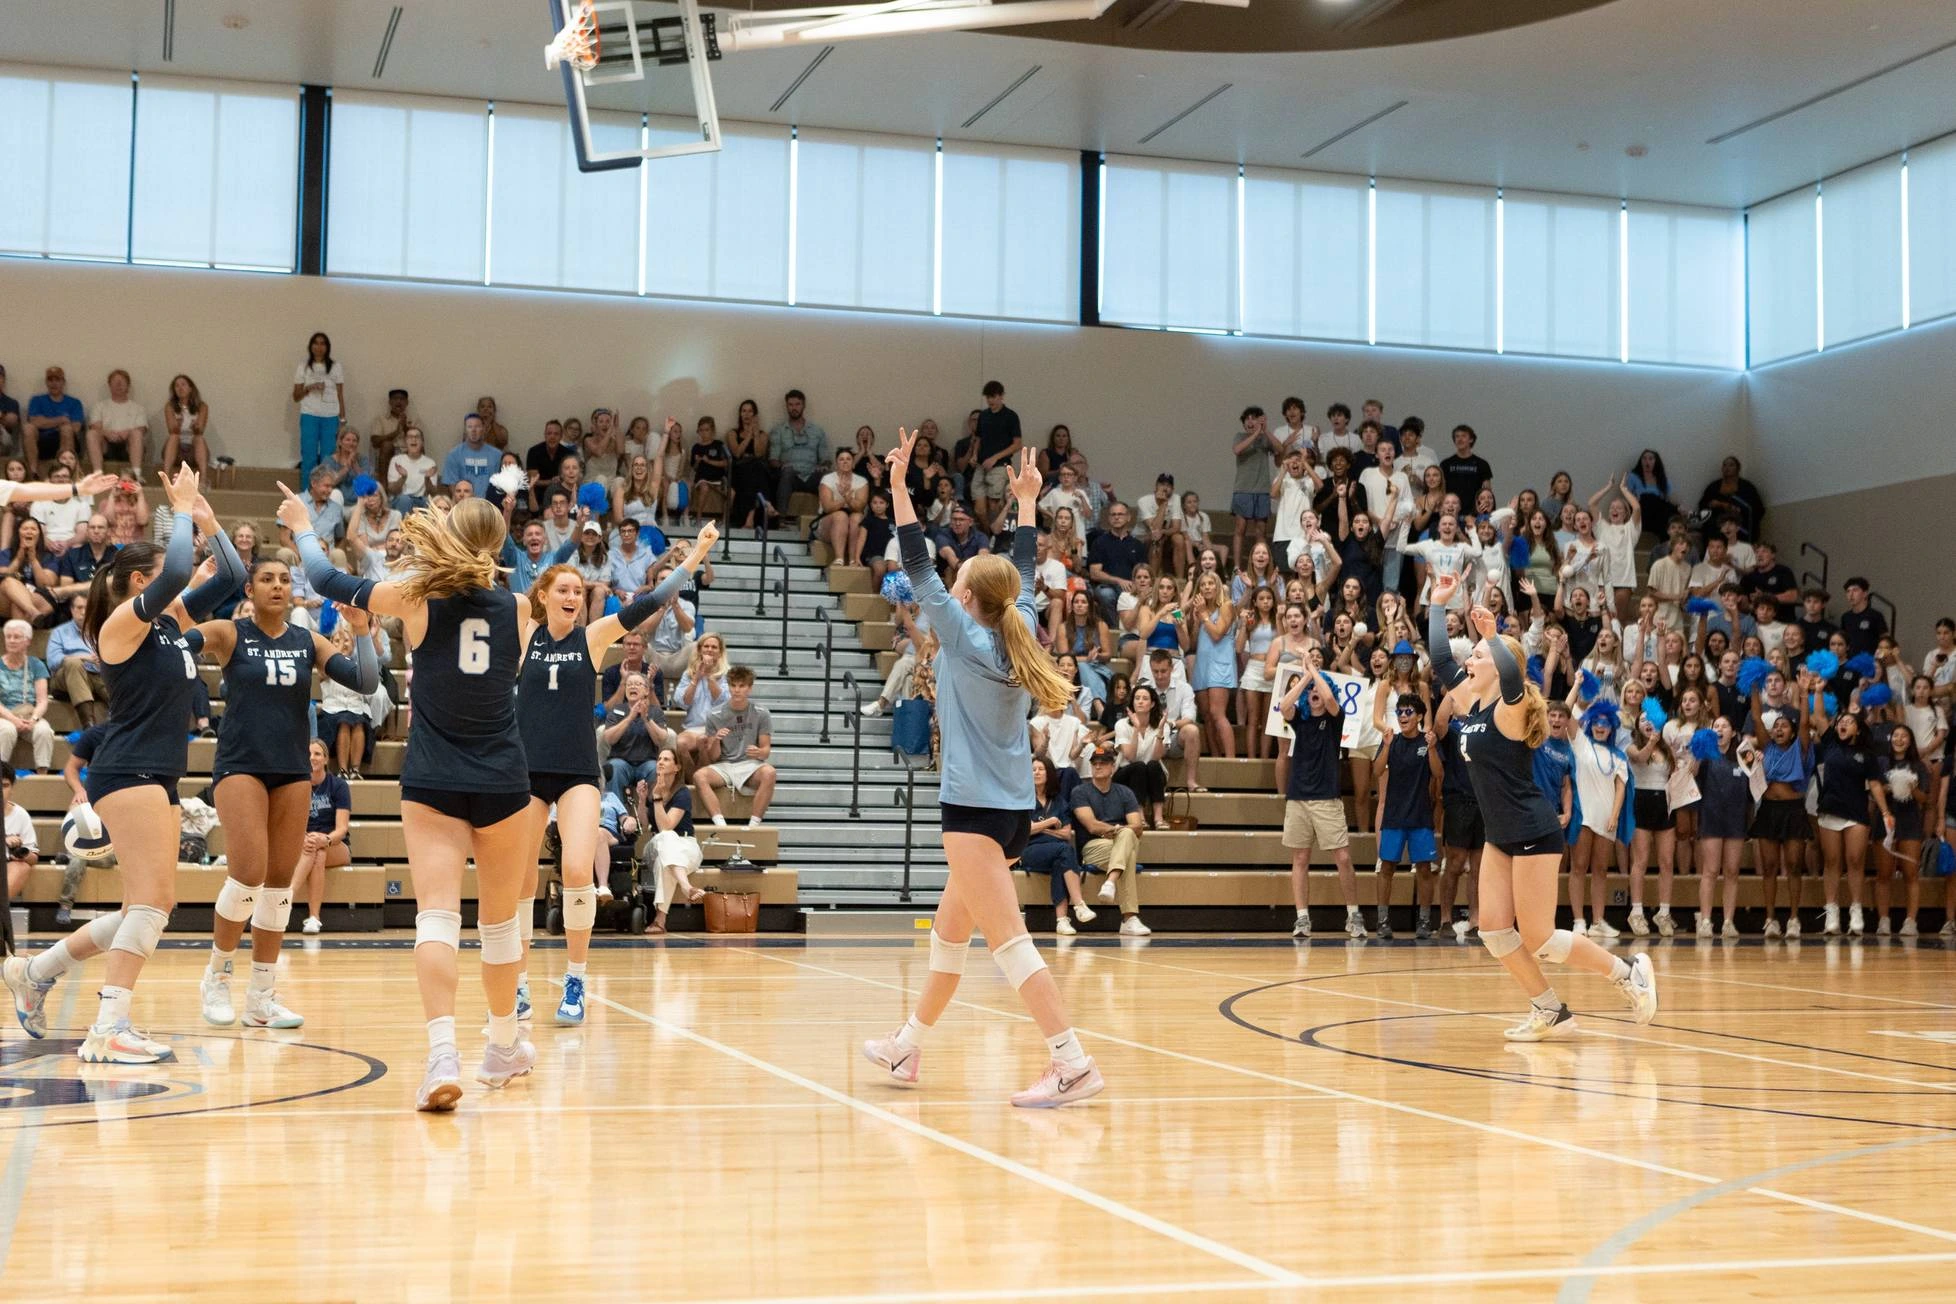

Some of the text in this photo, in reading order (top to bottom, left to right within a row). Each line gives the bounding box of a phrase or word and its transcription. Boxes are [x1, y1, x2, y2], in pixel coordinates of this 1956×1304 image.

[247, 647, 308, 659] ST. ANDREW'S
[458, 617, 490, 675] 6
[530, 650, 541, 661] ST.
[264, 658, 297, 686] 15
[548, 663, 560, 690] 1
[1341, 681, 1362, 716] 8
